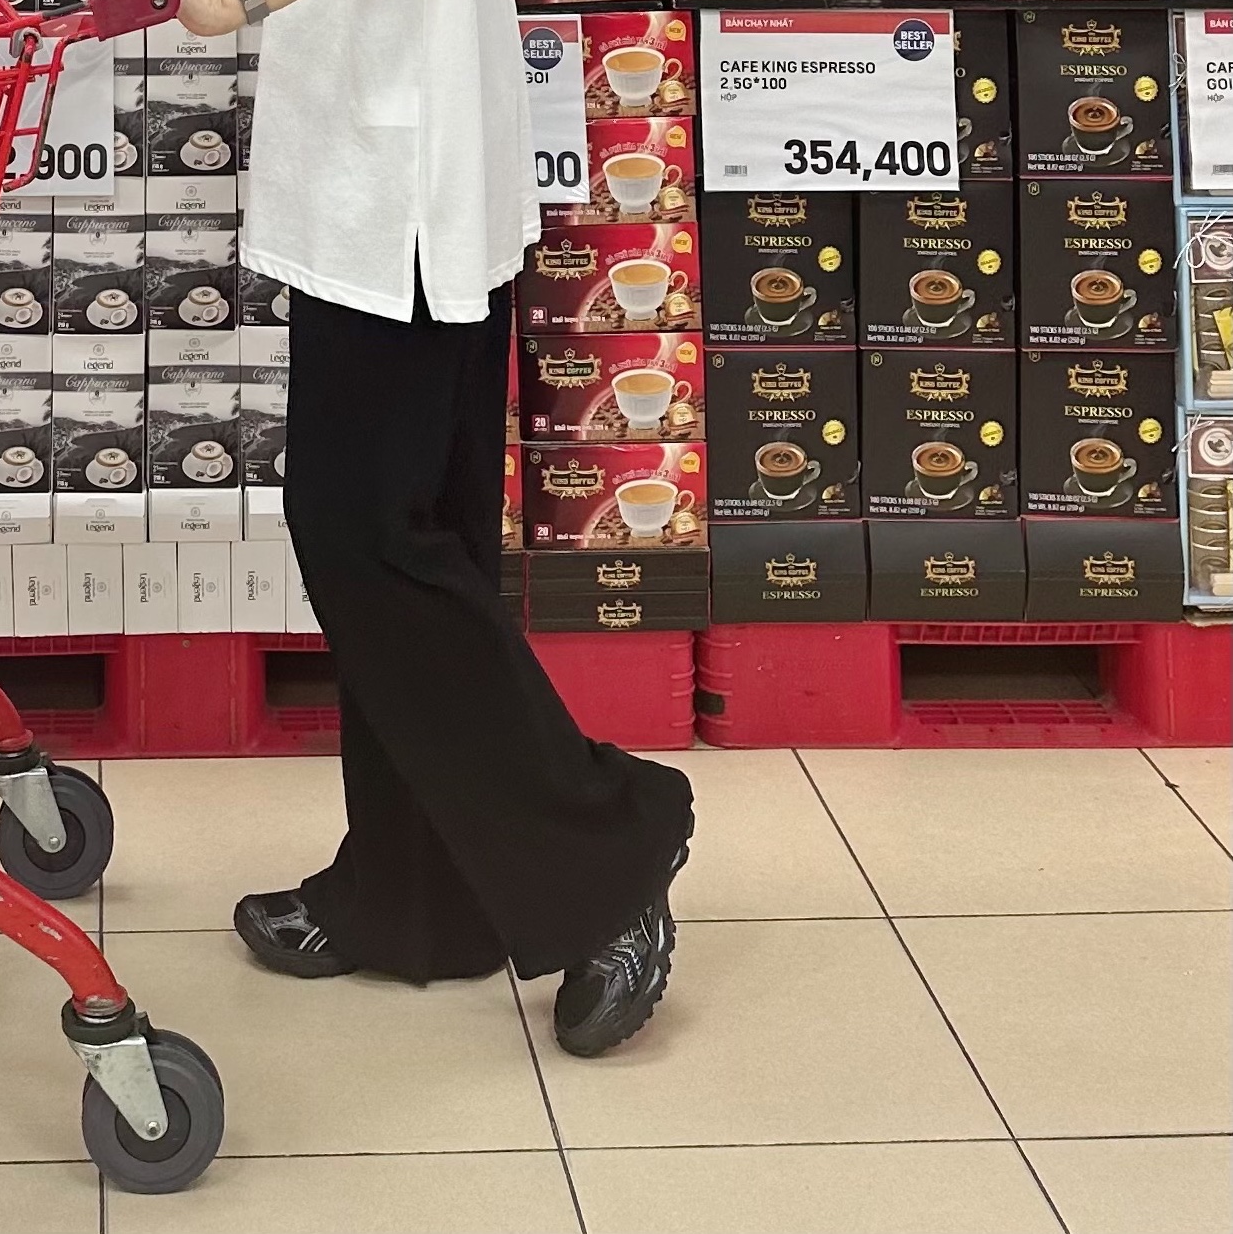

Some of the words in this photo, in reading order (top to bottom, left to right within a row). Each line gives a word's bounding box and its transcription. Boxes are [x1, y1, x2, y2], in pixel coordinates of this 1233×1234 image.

[725, 18, 744, 28] BÁN
[900, 31, 928, 40] BEST
[530, 40, 556, 49] BEST
[894, 40, 934, 50] SELLER
[524, 49, 562, 59] SELLER
[720, 61, 759, 74] CAFE
[762, 61, 798, 74] KING
[802, 61, 876, 74] ESPRESSO
[1058, 63, 1129, 77] ESPRESSO
[784, 139, 951, 182] 354,400
[174, 200, 207, 212] Legend
[158, 214, 221, 231] Cappuccino
[742, 234, 813, 248] ESPRESSO
[161, 366, 224, 383] Cappuccino
[1063, 405, 1134, 419] ESPRESSO
[179, 520, 212, 532] Legend
[919, 586, 979, 598] ESPRESSO
